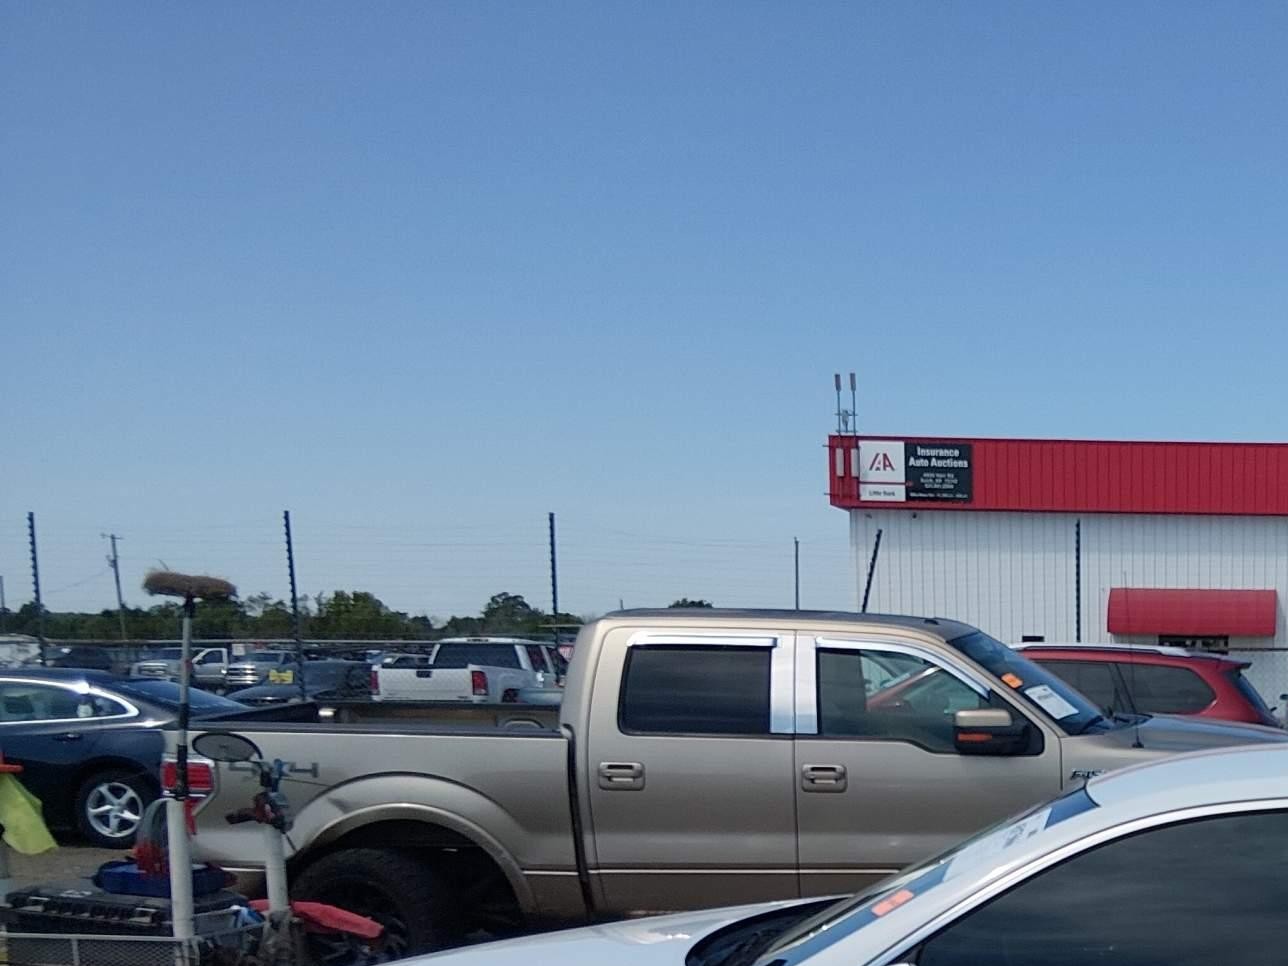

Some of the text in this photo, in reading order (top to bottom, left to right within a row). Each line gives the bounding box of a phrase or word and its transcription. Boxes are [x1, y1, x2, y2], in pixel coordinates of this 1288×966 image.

[916, 446, 960, 457] Insurance
[909, 456, 969, 468] Auto Auctions
